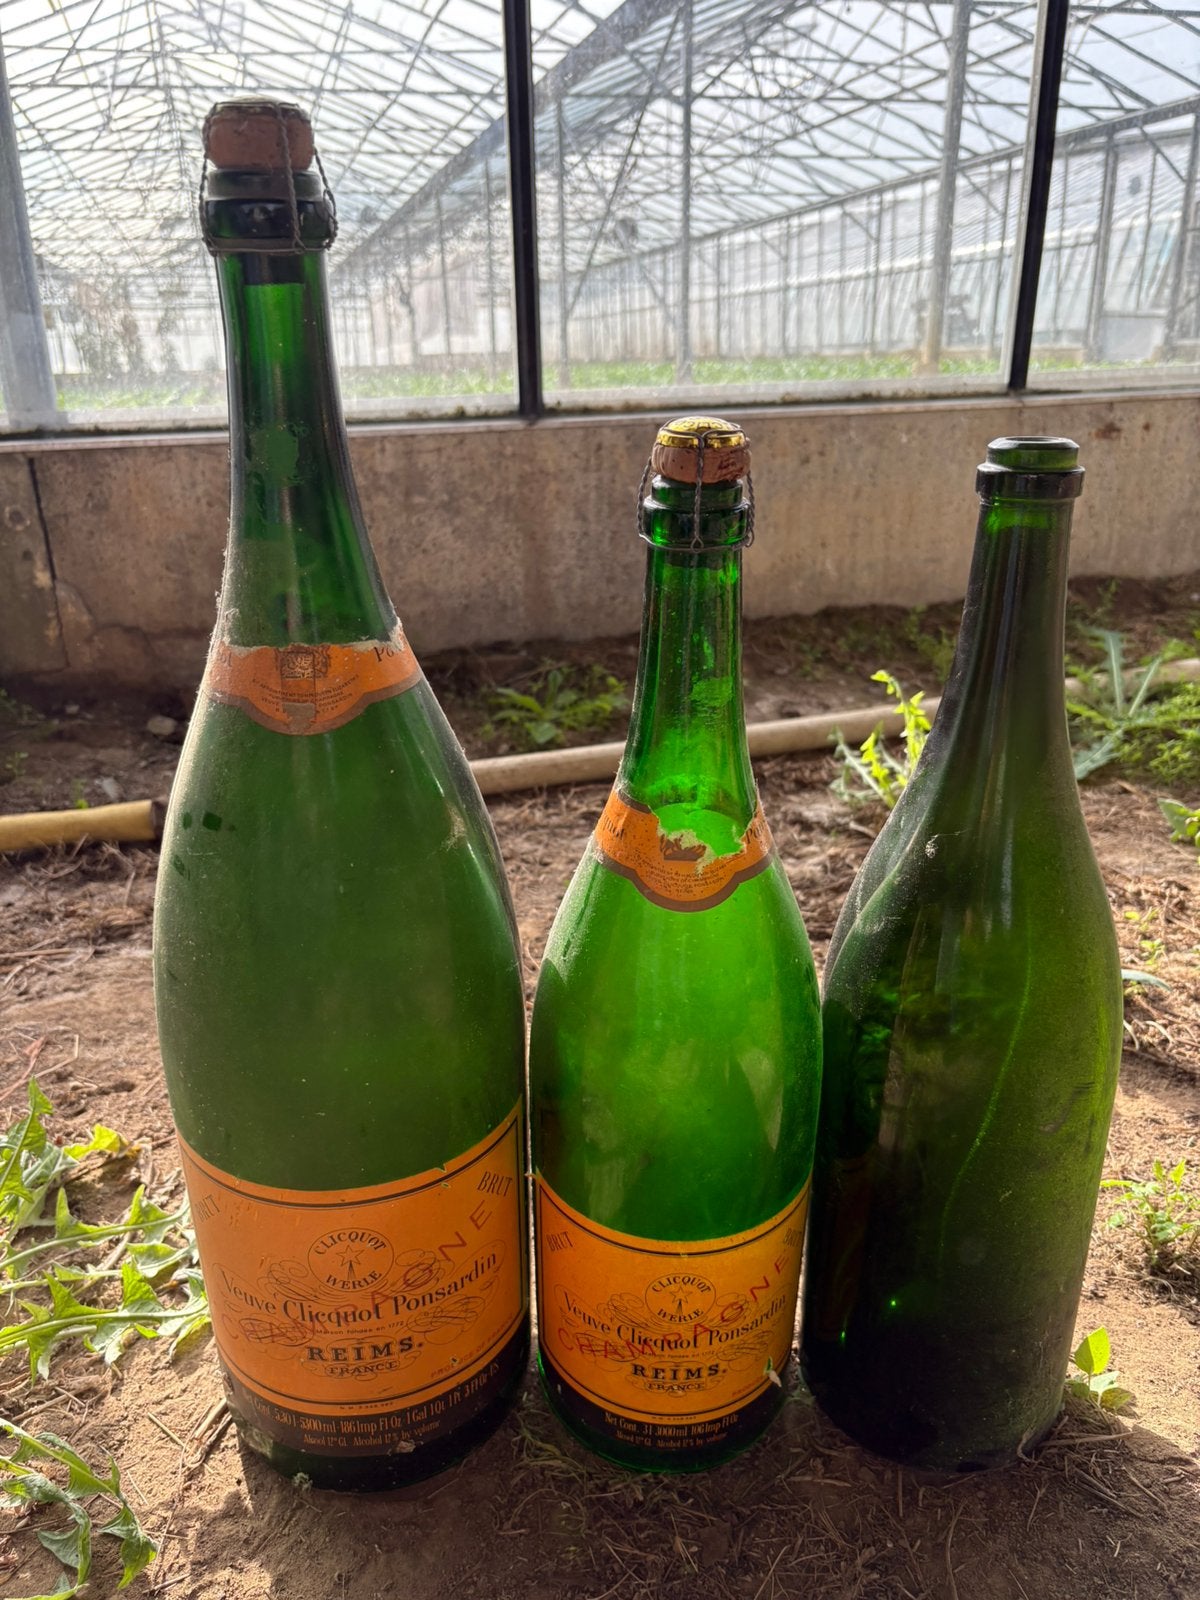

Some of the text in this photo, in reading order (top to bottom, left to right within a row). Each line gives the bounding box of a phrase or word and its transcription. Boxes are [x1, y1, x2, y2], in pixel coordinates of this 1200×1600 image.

[477, 1171, 513, 1198] BRUT
[314, 1230, 388, 1256] CLICQUOT
[544, 1231, 574, 1252] BRUT
[220, 1251, 498, 1328] Veuve Clicquot Ponsardin
[325, 1269, 383, 1291] WERLE
[651, 1275, 713, 1294] CLICQUOT
[557, 1254, 790, 1360] CHAMPAGNE
[655, 1307, 704, 1324] WERLE
[562, 1291, 612, 1335] Veuve
[616, 1325, 698, 1352] Clicquot
[708, 1294, 787, 1346] Ponsardin
[305, 1336, 424, 1362] REIMS.
[328, 1360, 400, 1375] FRANCE
[631, 1362, 729, 1380] REIMS.
[648, 1382, 706, 1392] FRANCE
[412, 1408, 427, 1422] Gal
